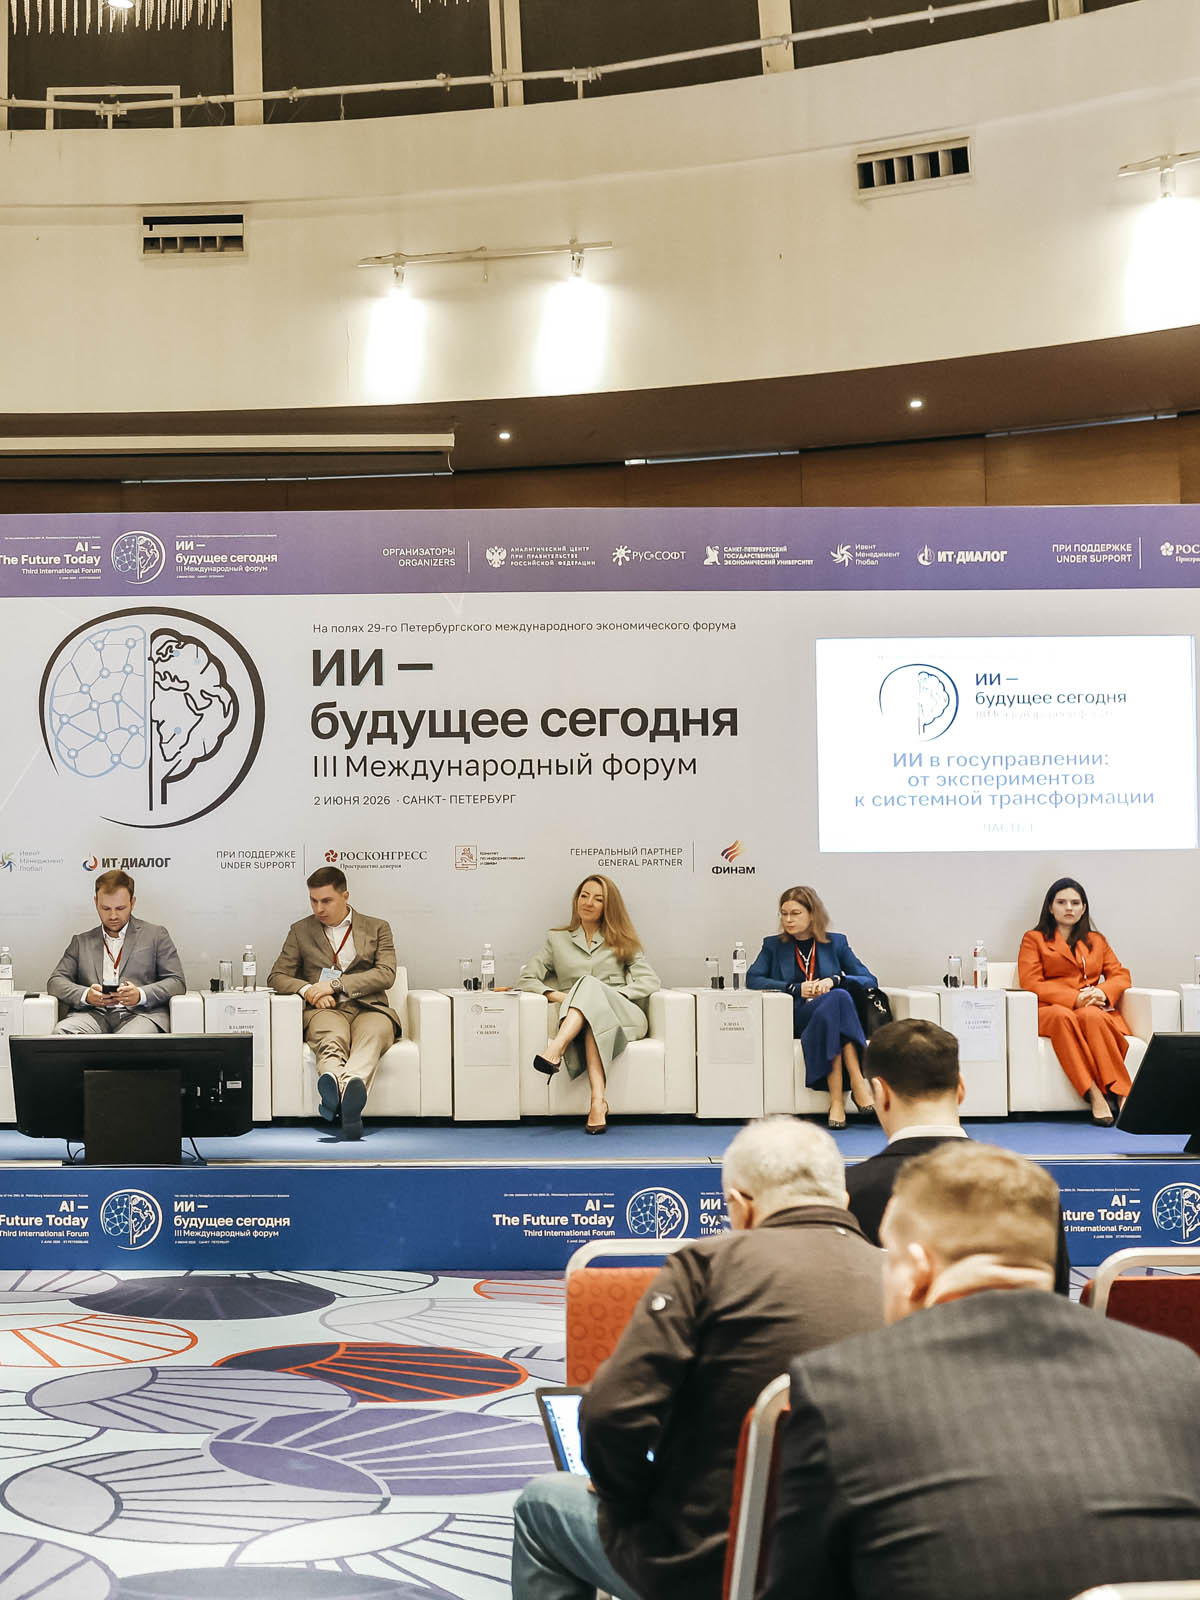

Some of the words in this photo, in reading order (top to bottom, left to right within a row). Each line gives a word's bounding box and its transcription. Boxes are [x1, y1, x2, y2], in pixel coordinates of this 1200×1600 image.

[75, 542, 89, 551] AI
[176, 541, 194, 550] ИИ
[382, 547, 455, 556] ОРГАНИЗАТОРЫ
[22, 555, 60, 564] Future
[64, 554, 101, 567] Today
[175, 554, 228, 565] будущее
[230, 554, 277, 564] сегодня
[399, 558, 455, 566] ORGANIZERS
[184, 565, 242, 573] Международный
[245, 565, 267, 573] форум
[313, 624, 328, 633] На
[331, 625, 364, 634] полях
[367, 623, 397, 632] 29-го
[401, 622, 492, 634] Петербургского
[495, 624, 593, 633] международного
[596, 623, 690, 632] экономического
[693, 621, 736, 633] форума
[313, 649, 383, 686] ИИ
[975, 673, 1000, 685] ИИ
[975, 692, 1052, 707] будущее
[1057, 692, 1127, 705] сегодня
[311, 702, 528, 750] будущее
[540, 707, 738, 742] сегодня
[894, 753, 923, 767] ИИ
[930, 756, 939, 767] в
[947, 752, 1109, 770] госуправлении:
[314, 756, 336, 777] III
[346, 753, 593, 782] Международный
[602, 754, 697, 780] форум
[908, 775, 929, 787] от
[936, 772, 1094, 789] экспериментов
[314, 796, 320, 805] 2
[324, 795, 360, 805] ИЮНЯ
[363, 795, 390, 805] 2026
[449, 794, 515, 804] ПЕТЕРБУРГ
[855, 795, 864, 807] к
[872, 791, 982, 807] системной
[989, 791, 1154, 809] трансформации
[239, 851, 295, 859] ПОДДЕРЖКЕ
[340, 851, 427, 860] РОСКОНГРЕСС
[570, 846, 637, 856] ГЕНЕРАЛЬНЫЙ
[254, 861, 296, 869] SUPPORT
[1111, 1195, 1126, 1206] AI
[59, 1201, 74, 1212] AI
[174, 1201, 194, 1212] ИИ
[46, 1215, 88, 1228] Today
[174, 1215, 233, 1228] будущее
[235, 1217, 290, 1228] сегодня
[1098, 1209, 1141, 1223] Today
[183, 1229, 250, 1238] Международный
[252, 1230, 279, 1238] форум
